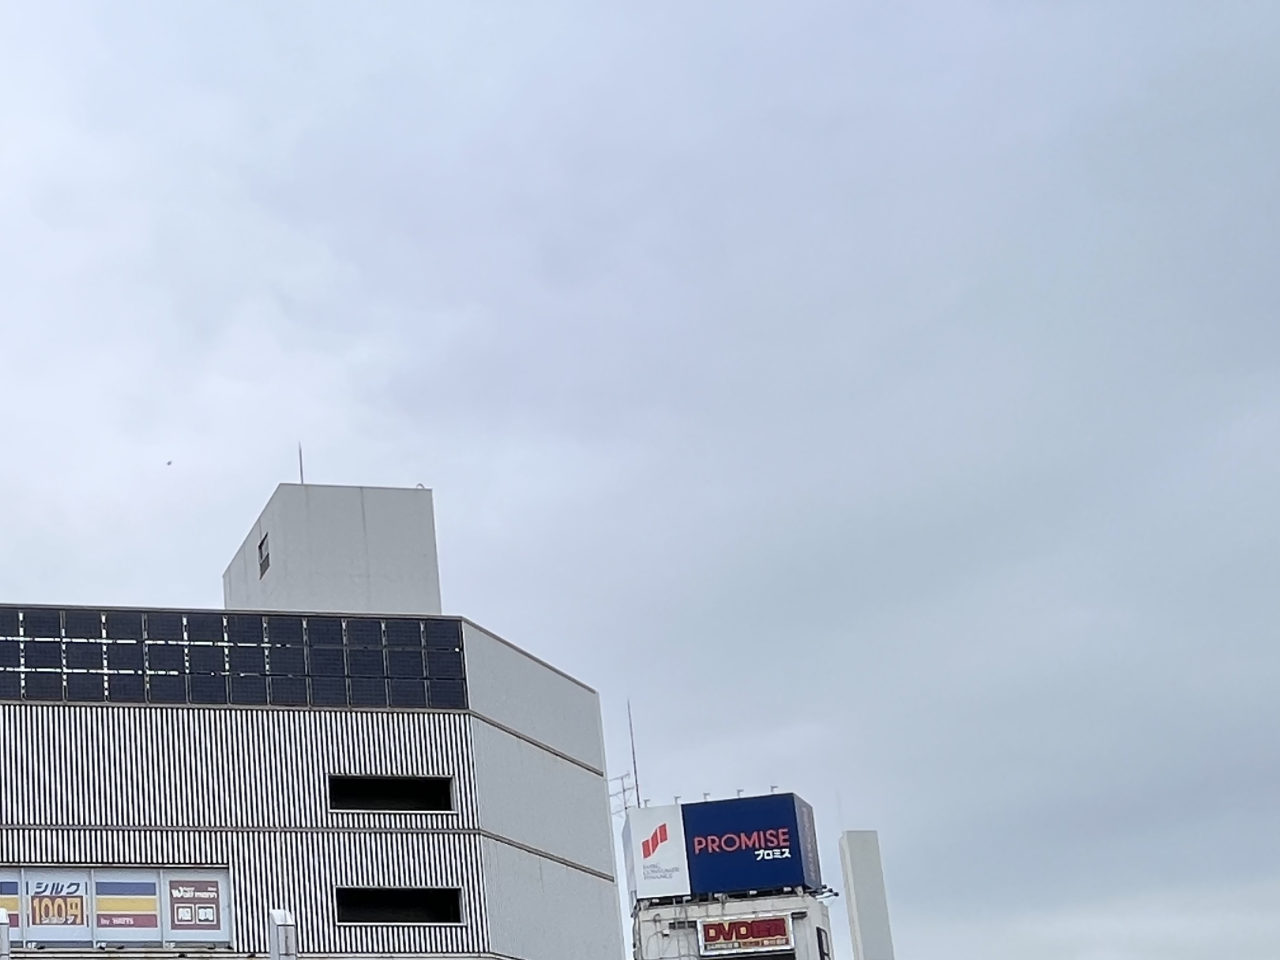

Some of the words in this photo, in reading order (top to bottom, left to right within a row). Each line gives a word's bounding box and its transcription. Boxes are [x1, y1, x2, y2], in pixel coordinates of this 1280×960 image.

[694, 828, 790, 855] PROMISE
[754, 848, 791, 861] プロミス
[34, 882, 81, 894] シルク
[33, 898, 82, 924] 100円
